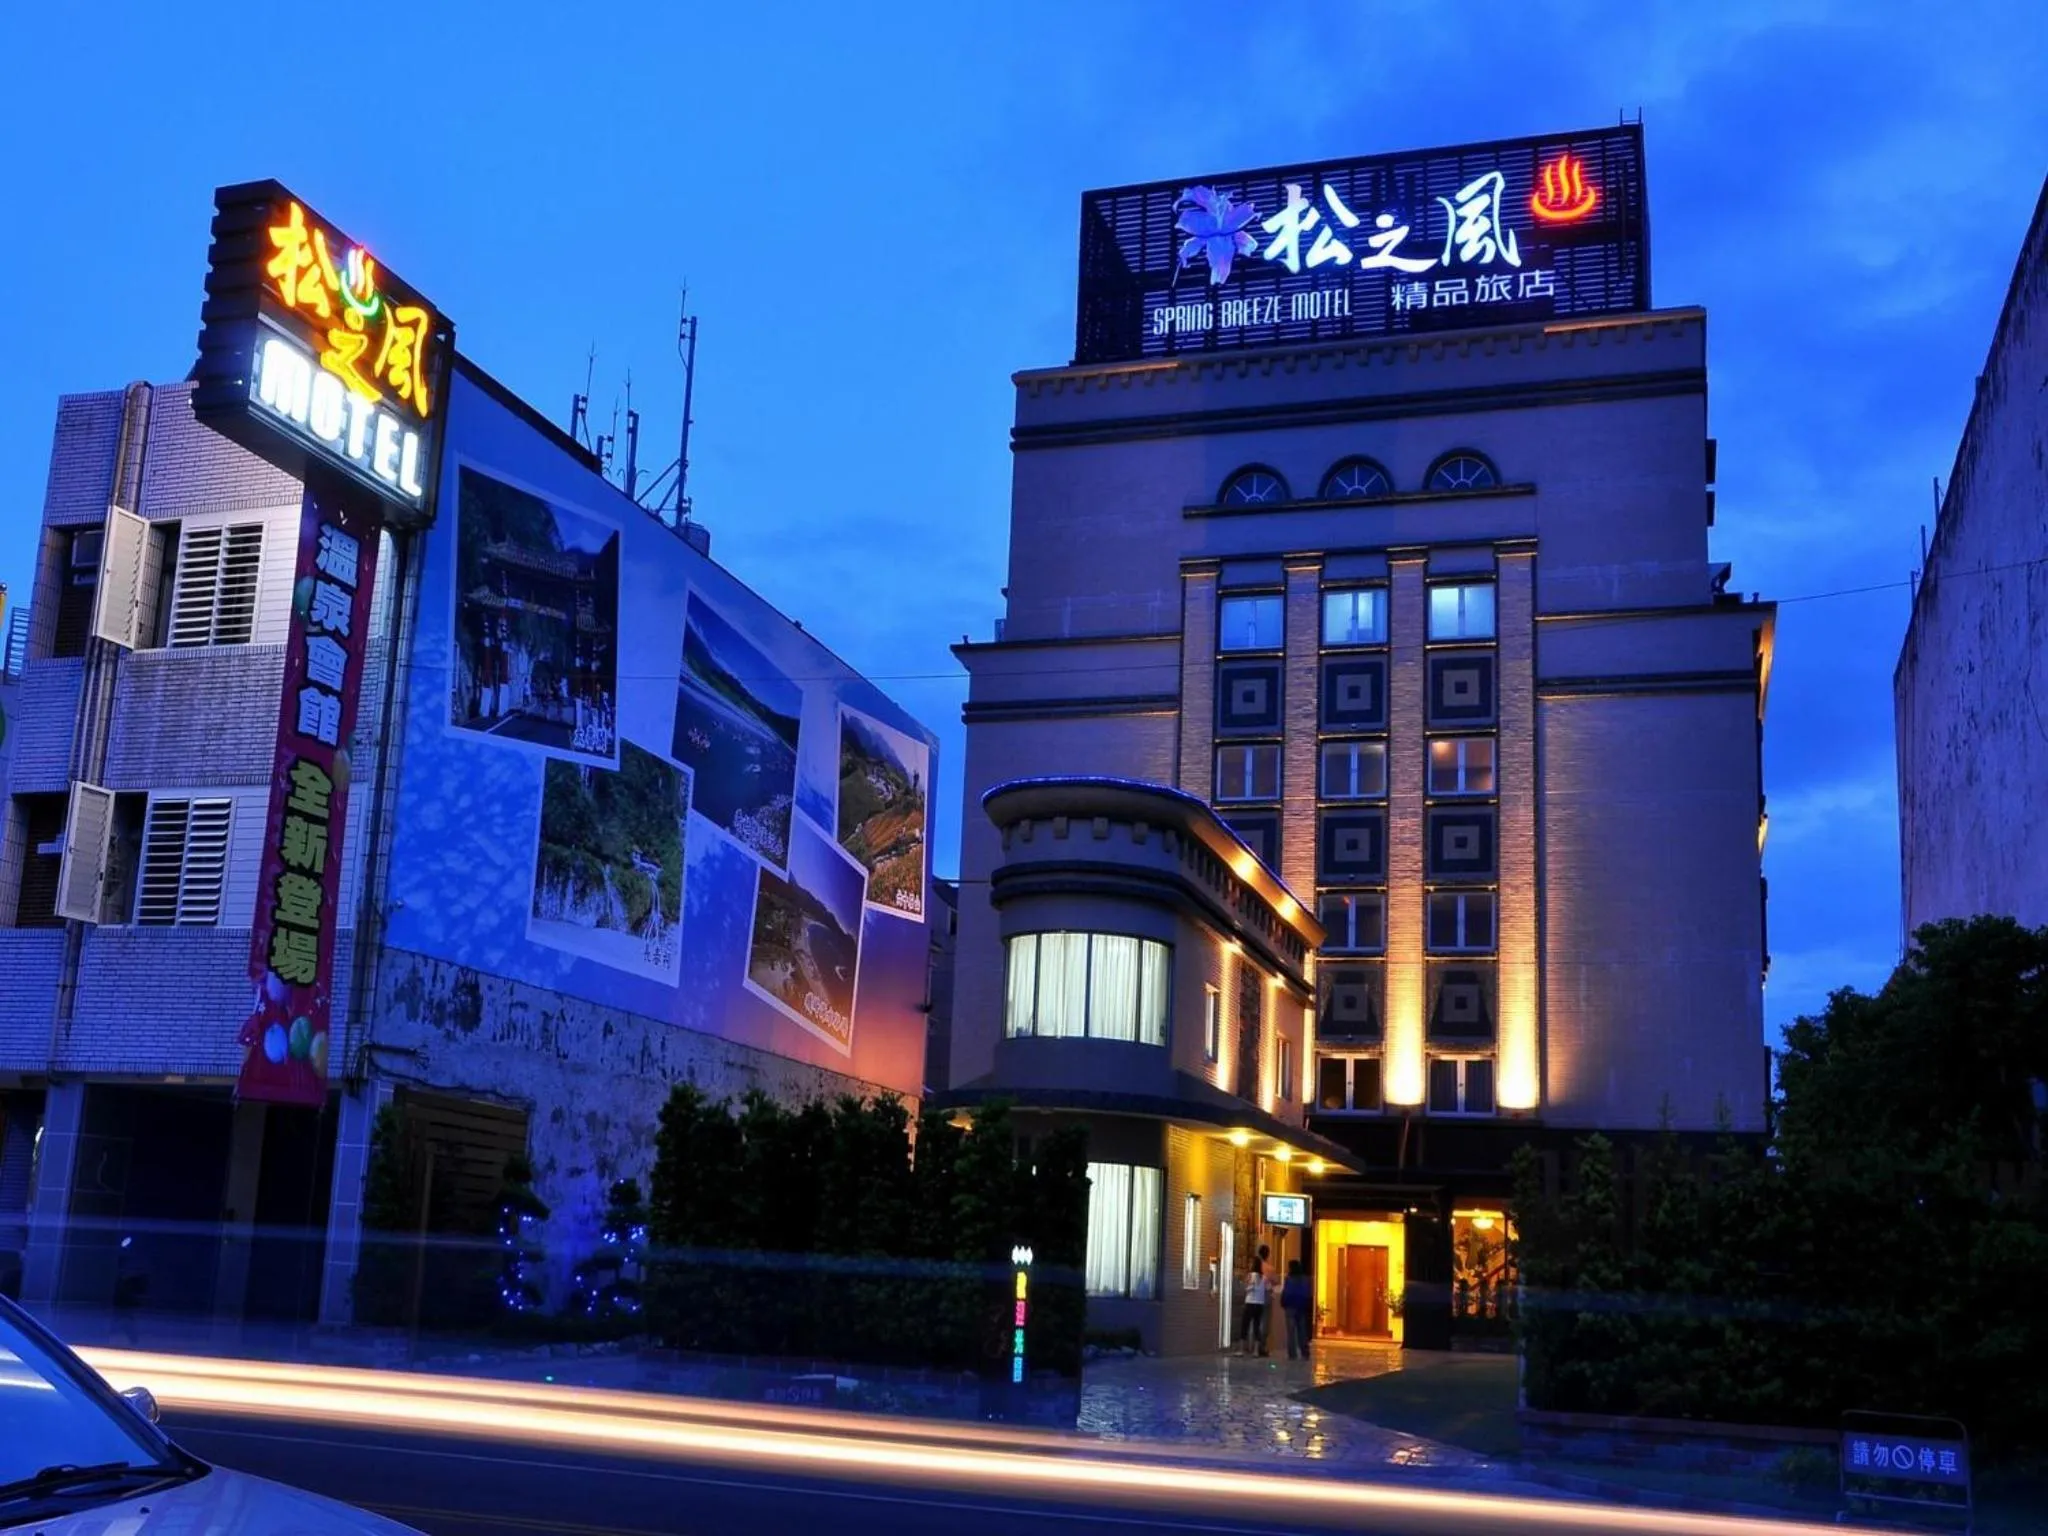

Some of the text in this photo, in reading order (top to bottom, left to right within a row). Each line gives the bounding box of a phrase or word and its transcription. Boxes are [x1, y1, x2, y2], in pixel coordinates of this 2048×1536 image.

[1261, 171, 1522, 274] 松之風
[266, 200, 429, 418] 松之風
[1153, 288, 1353, 336] SPRING BREEZE MOTEL
[1391, 269, 1556, 312] 精品旅店
[258, 338, 423, 498] MOTEL
[296, 522, 361, 747] 溫泉會館
[268, 759, 335, 986] 全新登場
[1852, 1440, 1958, 1475] 請勿 停車
